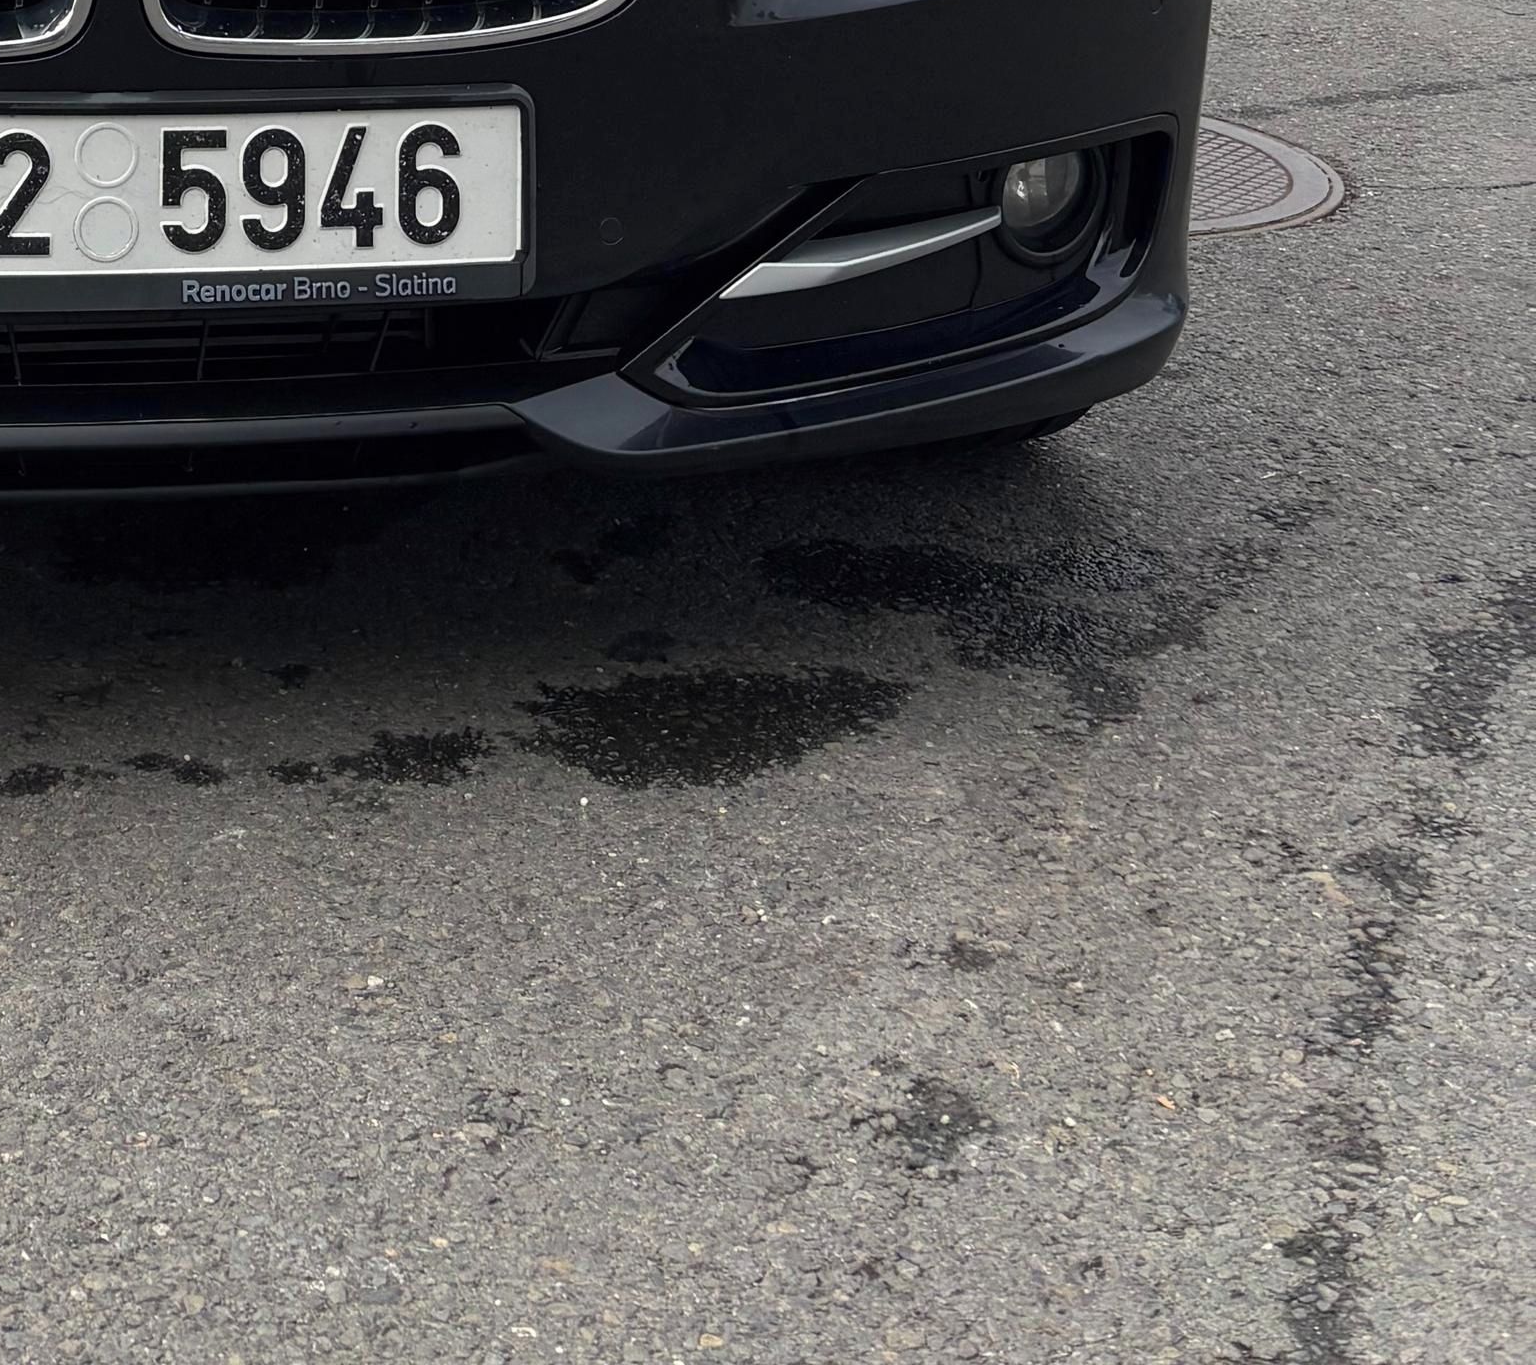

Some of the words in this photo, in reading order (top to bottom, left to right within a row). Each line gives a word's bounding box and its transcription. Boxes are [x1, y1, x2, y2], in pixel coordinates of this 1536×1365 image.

[159, 121, 463, 255] 5946
[181, 279, 287, 303] Renocar
[293, 276, 351, 300] Brno
[375, 272, 457, 297] Slatina
